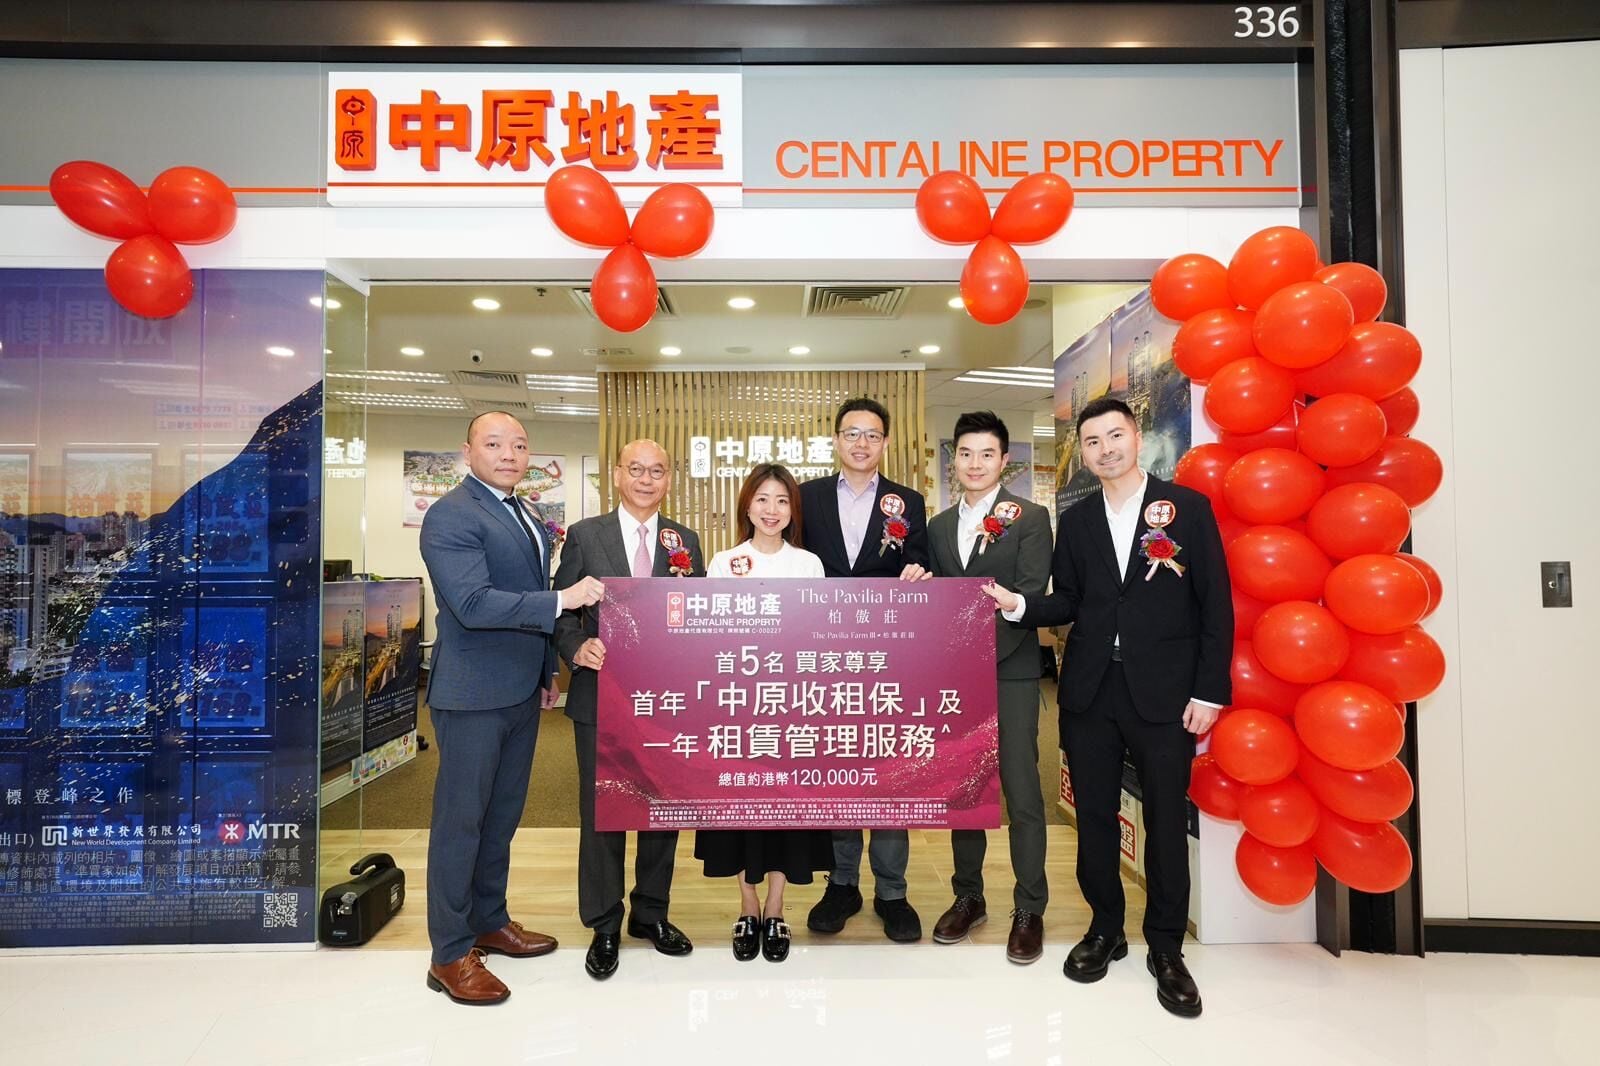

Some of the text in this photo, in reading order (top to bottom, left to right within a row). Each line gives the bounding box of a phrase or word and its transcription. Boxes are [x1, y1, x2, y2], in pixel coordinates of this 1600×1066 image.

[1234, 6, 1299, 38] 336
[388, 89, 724, 171] 中原地產
[776, 139, 1283, 179] CENTALINE PROPERTY
[715, 436, 834, 464] 中原地產
[797, 587, 929, 603] The Pavilia Farm
[686, 593, 782, 616] 中原地產
[686, 618, 782, 627] CENTALINE PROPERTY
[828, 608, 898, 624] 柏傲莊
[811, 631, 826, 639] The
[715, 645, 888, 676] 首5名 買家尊享
[718, 767, 878, 787] 總值約港幣120,000元
[6, 787, 133, 805] 標登峰之作
[72, 825, 201, 837] 新世界發展有限公司
[248, 823, 300, 839] MTR
[106, 839, 144, 847] Development
[145, 839, 177, 847] Company
